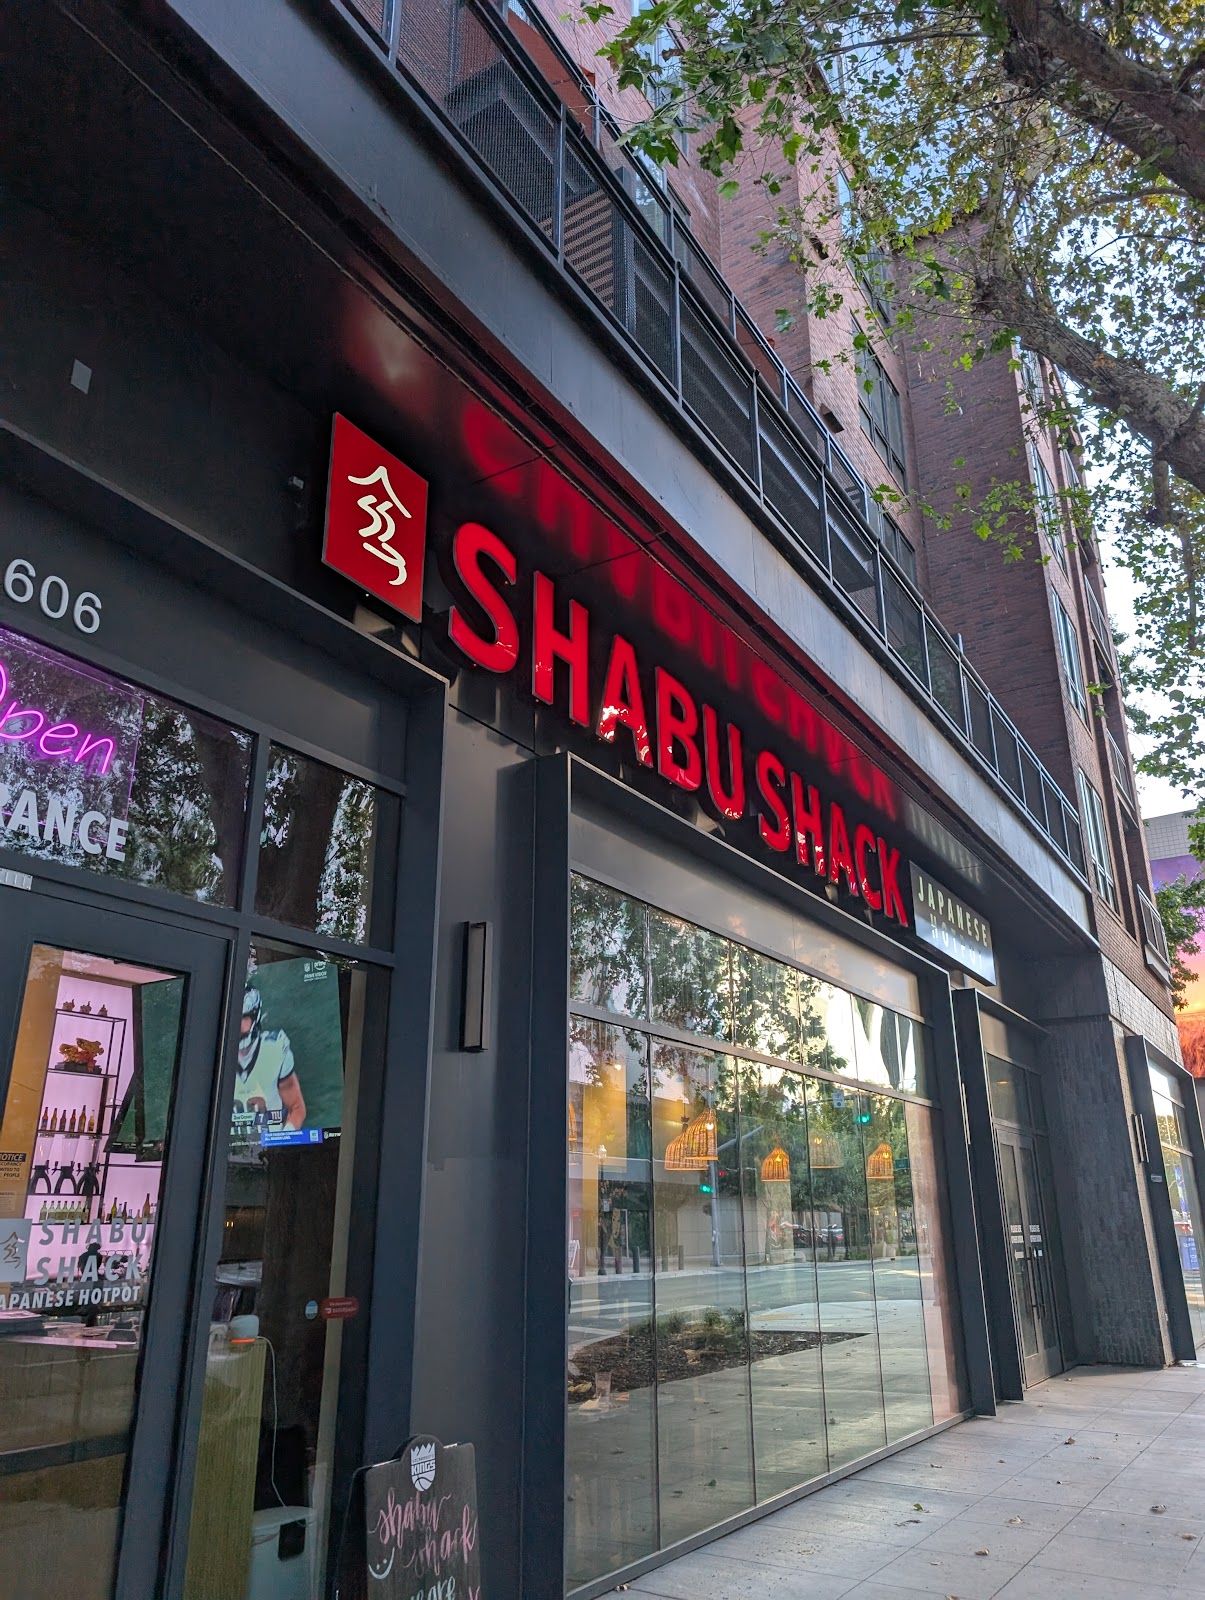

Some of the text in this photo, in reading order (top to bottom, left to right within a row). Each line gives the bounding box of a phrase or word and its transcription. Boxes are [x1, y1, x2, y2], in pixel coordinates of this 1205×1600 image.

[3, 558, 103, 634] 606
[449, 522, 909, 928] SHABU SHACK
[918, 876, 988, 948] JAPANESE
[39, 1217, 148, 1246] SHABU
[34, 1253, 141, 1286] SHACK
[78, 1285, 141, 1307] HOTPOT
[411, 1459, 436, 1476] KINGS
